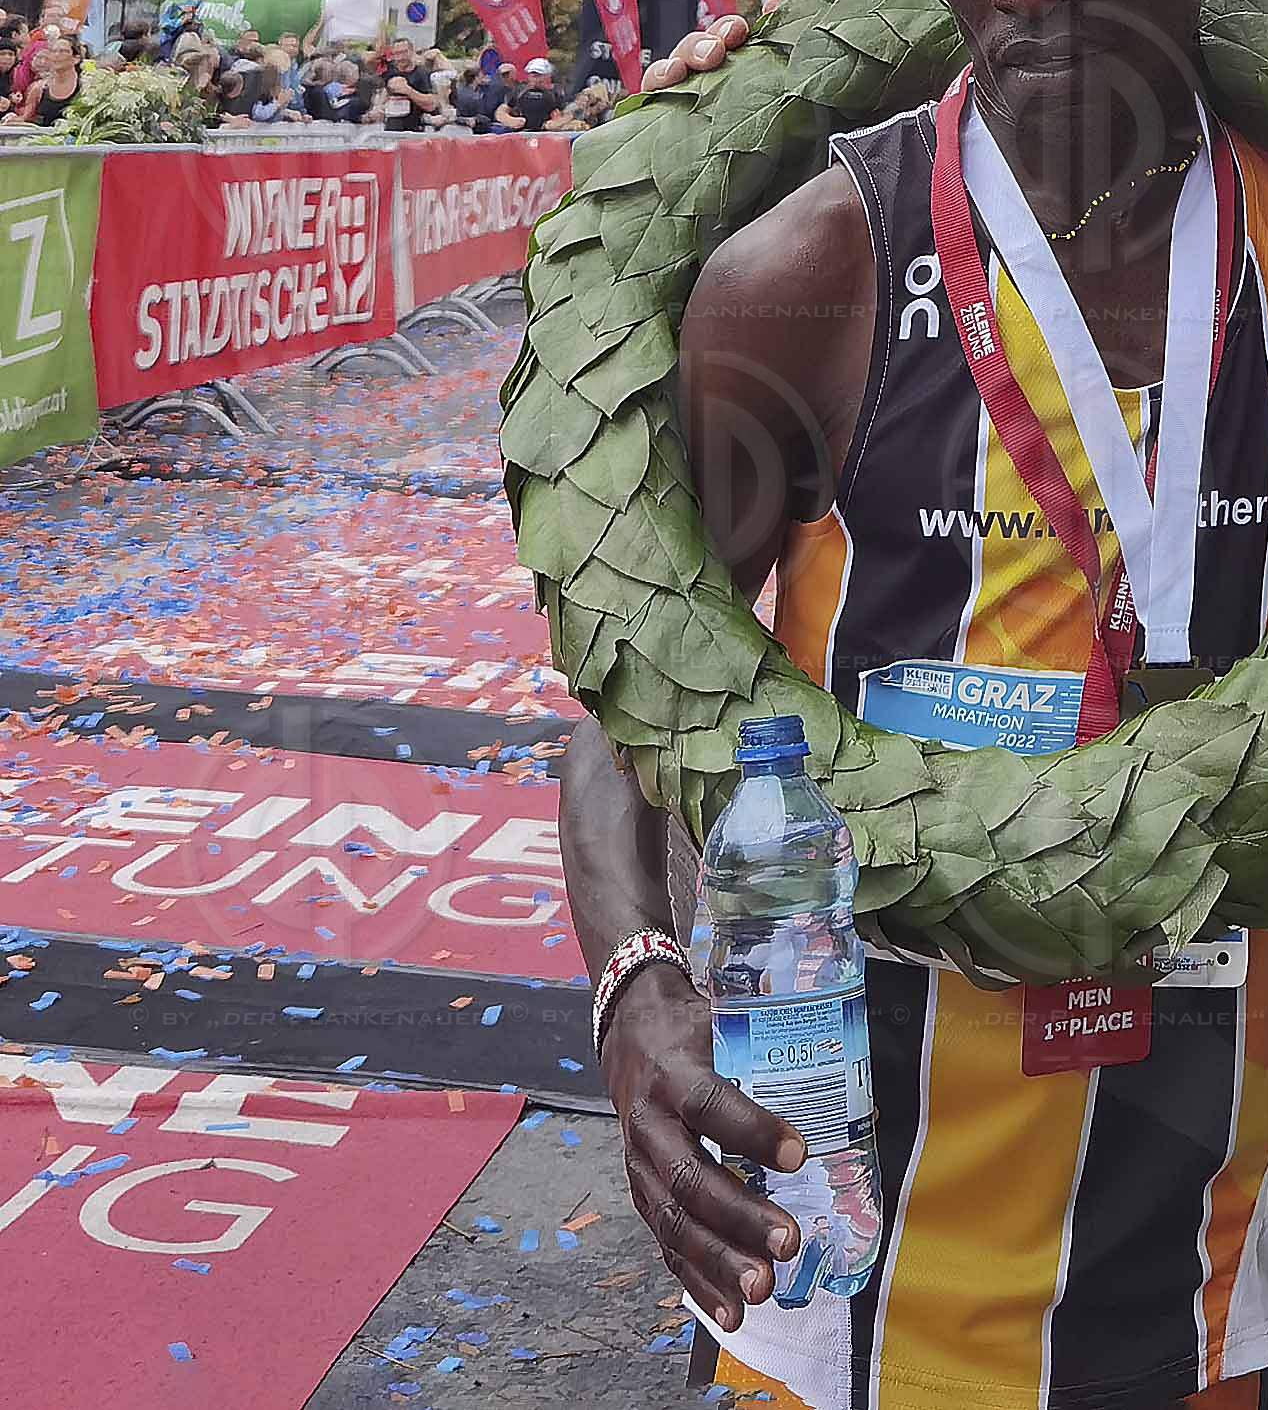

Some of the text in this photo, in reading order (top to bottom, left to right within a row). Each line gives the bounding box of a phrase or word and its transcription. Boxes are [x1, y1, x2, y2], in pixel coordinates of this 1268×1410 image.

[221, 177, 342, 259] WIENER
[960, 304, 984, 360] ZEITUNG
[972, 301, 996, 357] KLEINE
[1109, 572, 1130, 631] KLEINE
[905, 669, 952, 684] KLEINE
[957, 675, 1057, 713] GRAZ
[932, 702, 1025, 731] MARATHON
[995, 732, 1037, 750] 2022
[1067, 986, 1112, 1011] MEN
